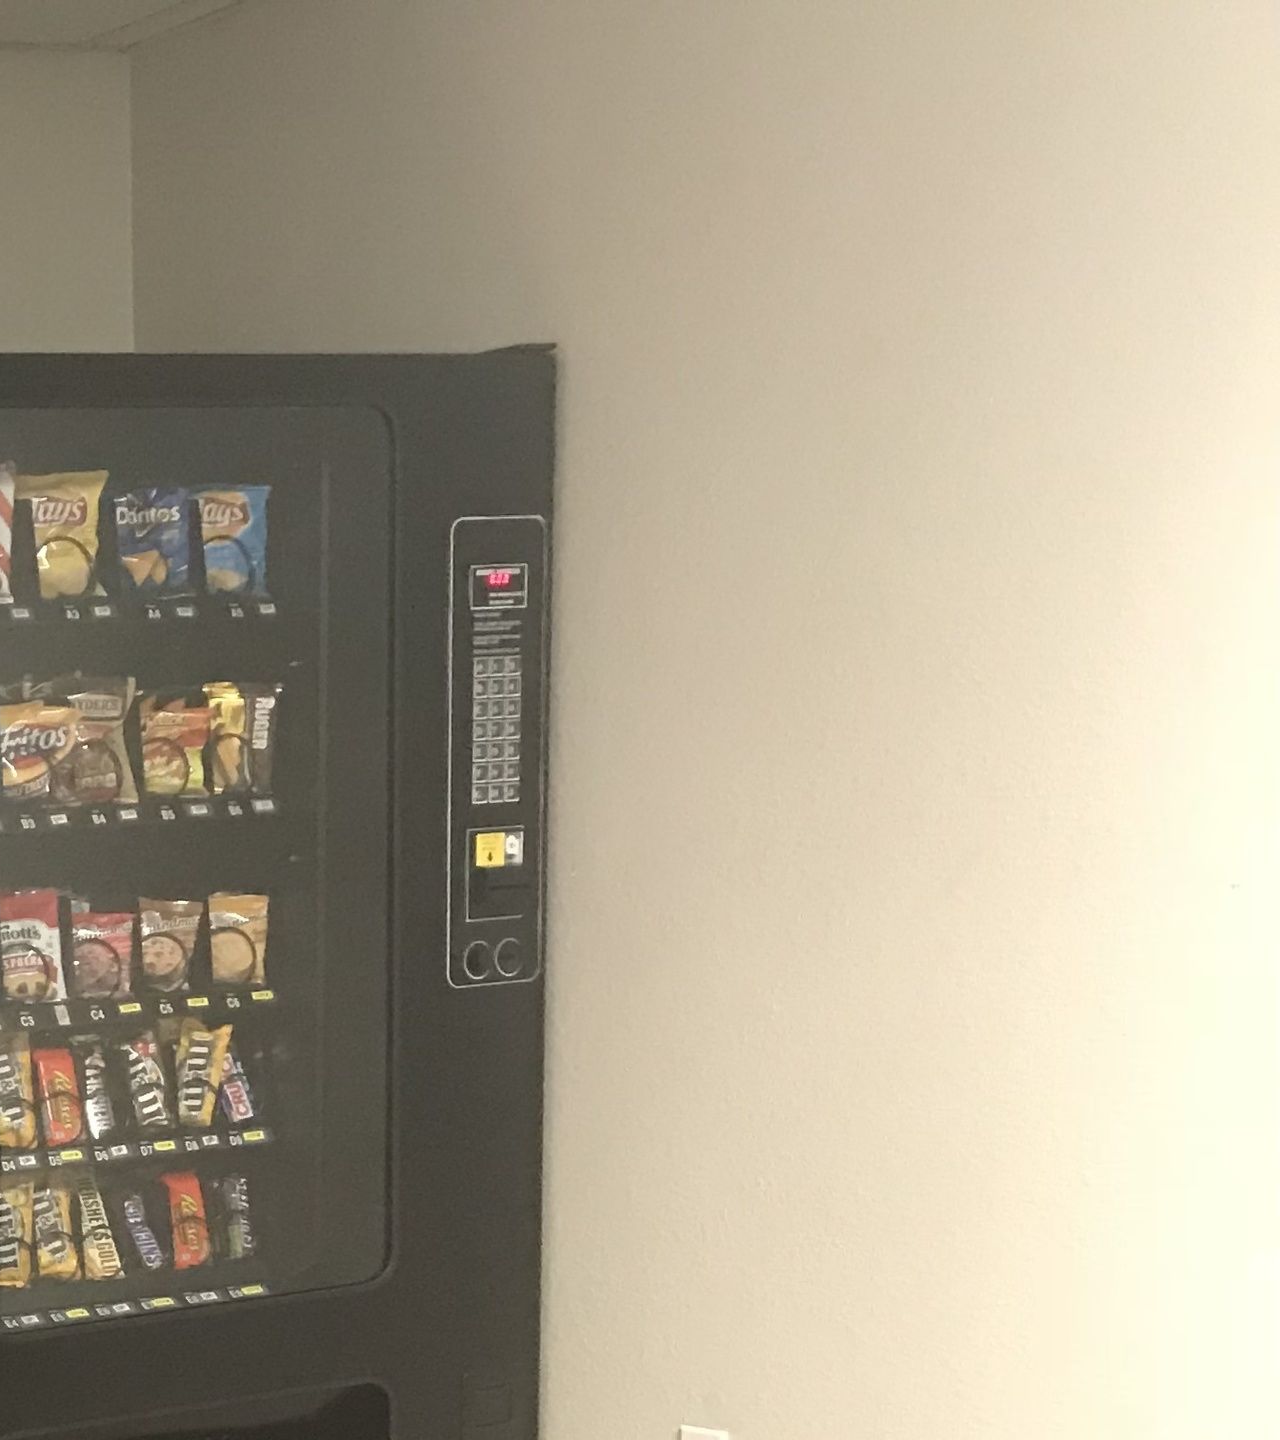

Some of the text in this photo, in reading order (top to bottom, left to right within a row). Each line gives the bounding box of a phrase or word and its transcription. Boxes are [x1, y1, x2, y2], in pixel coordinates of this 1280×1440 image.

[115, 505, 181, 525] Doritos
[0, 721, 69, 753] Fritos
[90, 1009, 105, 1020] C4
[20, 1016, 35, 1026] C3
[140, 1145, 153, 1156] D7
[1, 1160, 16, 1171] D4
[79, 1180, 113, 1241] HERSHES
